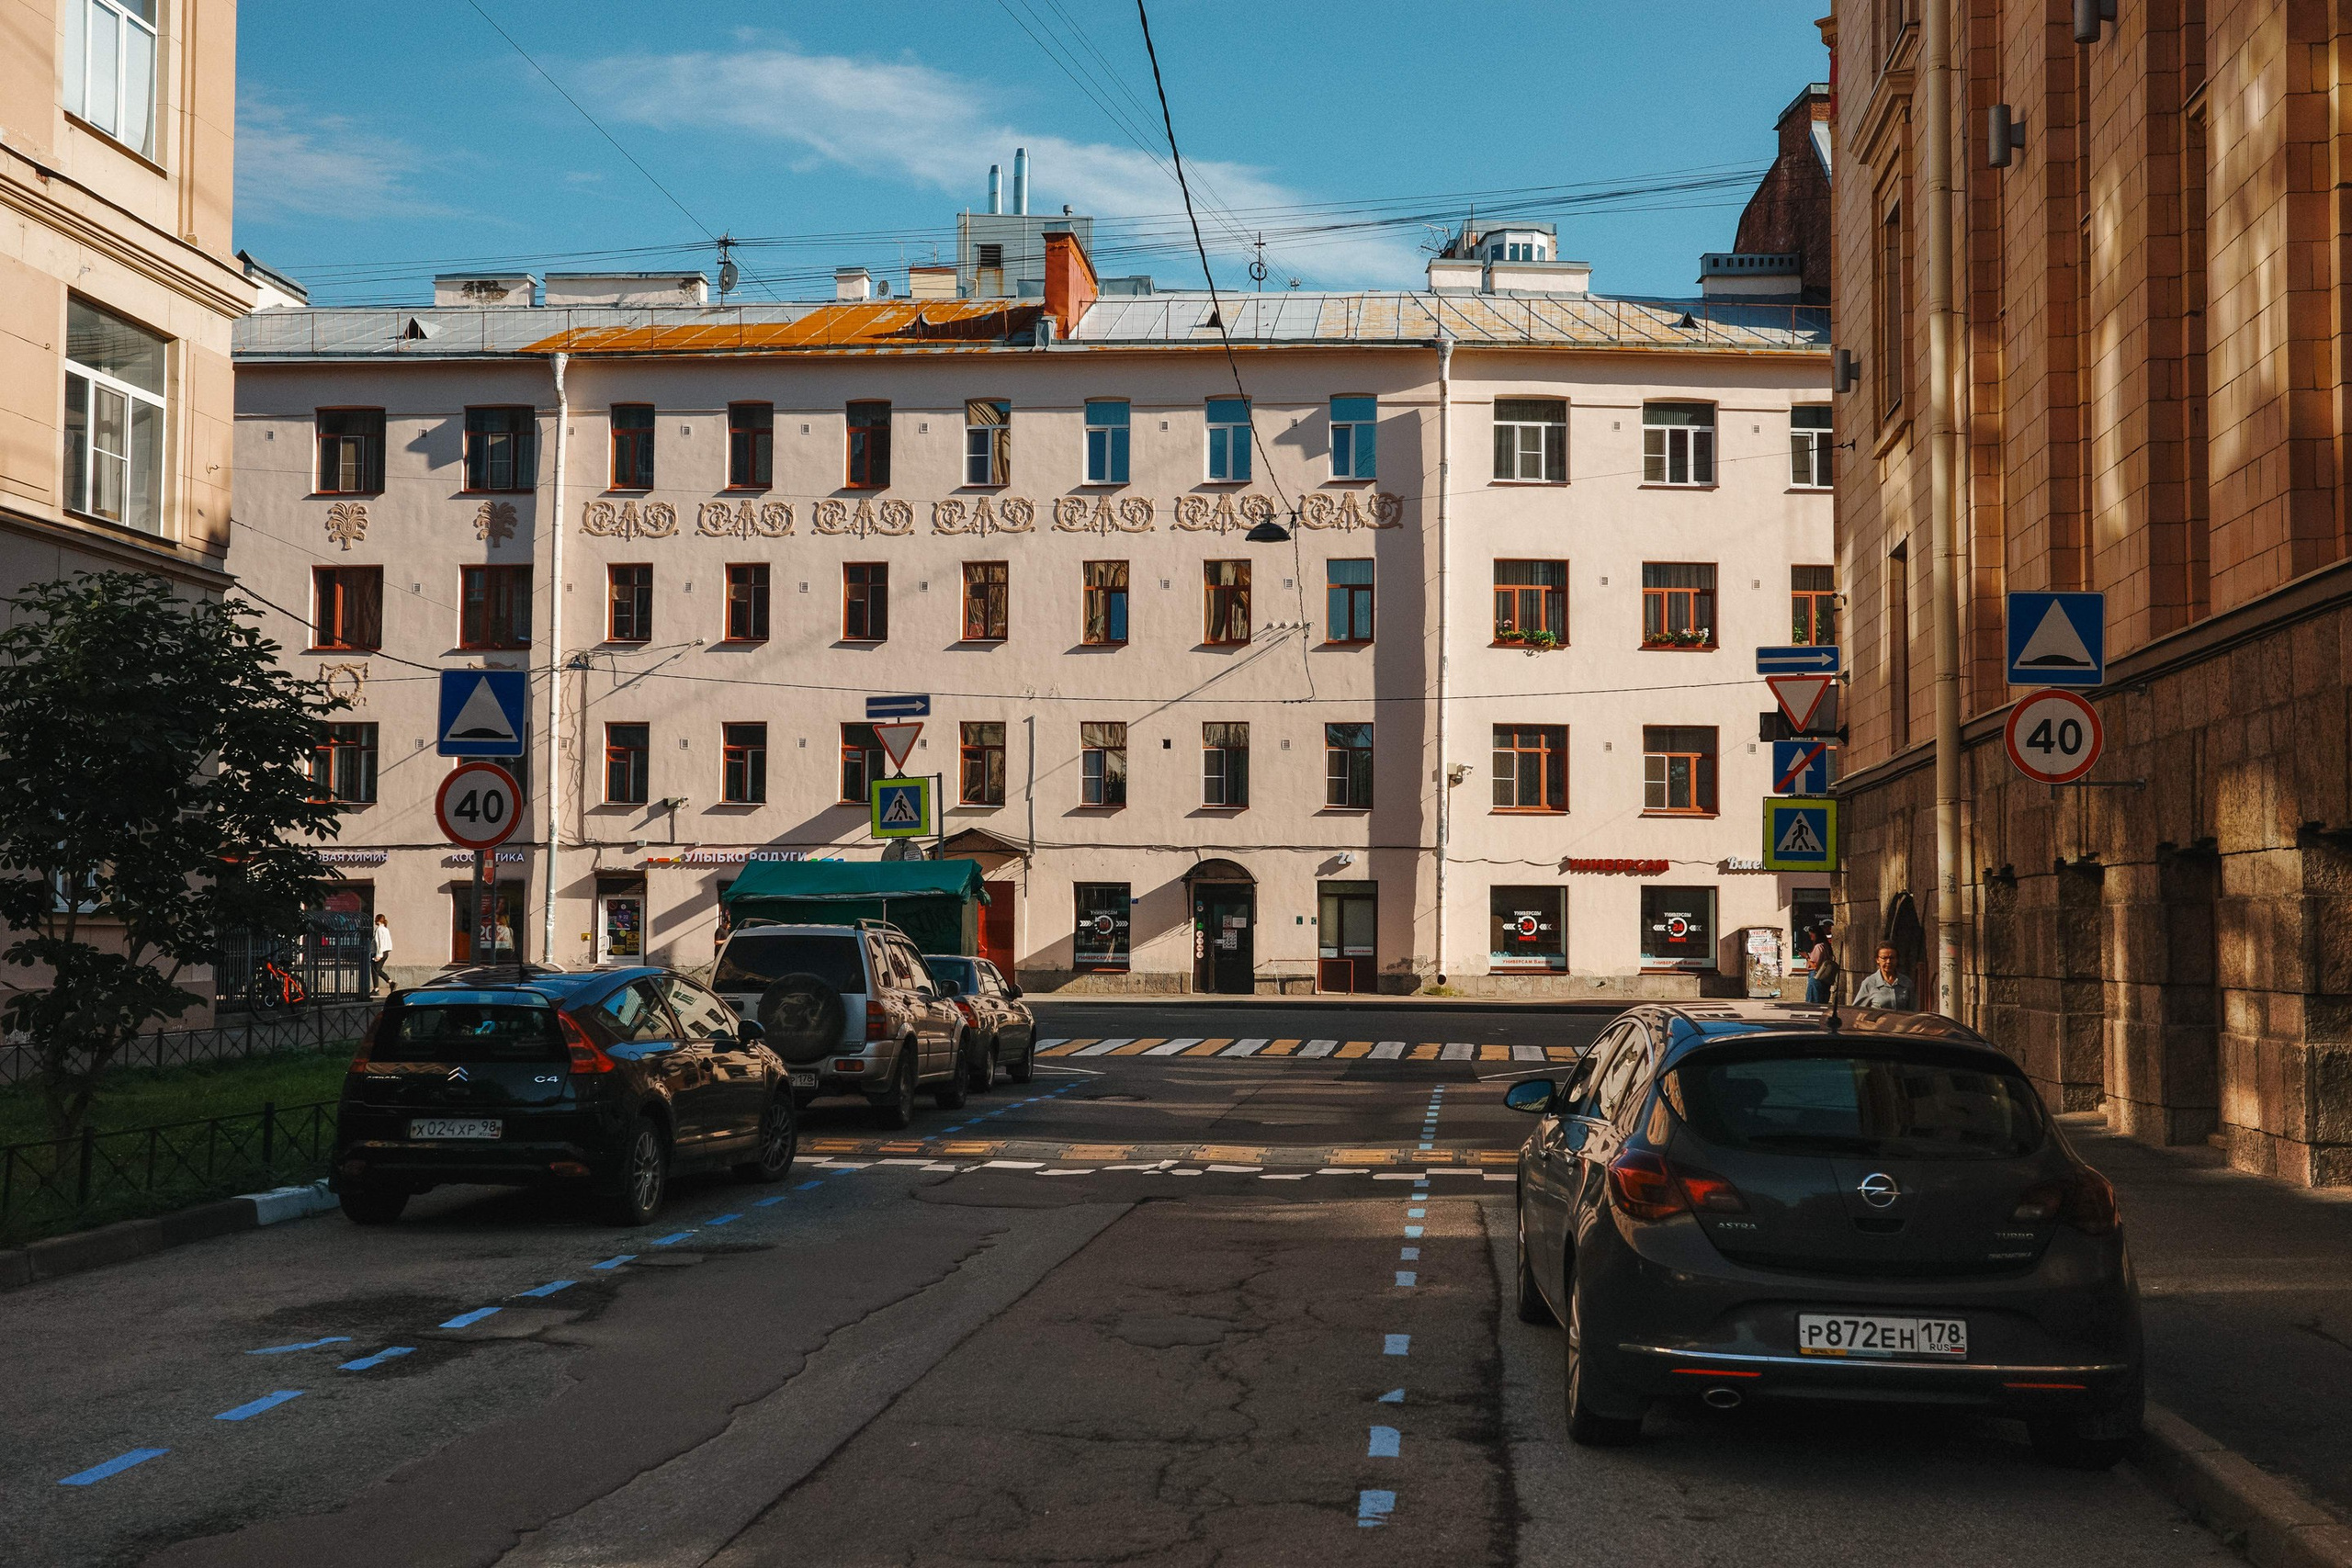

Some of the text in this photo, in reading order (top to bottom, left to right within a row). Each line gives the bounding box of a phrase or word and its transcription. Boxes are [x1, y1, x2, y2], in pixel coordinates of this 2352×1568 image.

[2026, 718, 2083, 755] 40
[454, 789, 504, 824] 40
[346, 852, 389, 862] ХИМИЯ
[452, 852, 524, 863] КОСТИКА
[1338, 852, 1355, 864] 24
[1727, 855, 1763, 870] Вме
[1568, 858, 1669, 872] УНИВЕРСАМ
[1522, 920, 1534, 931] 24
[1672, 922, 1684, 931] 24
[533, 1075, 559, 1083] C4
[797, 1074, 813, 1083] 178
[481, 1120, 497, 1132] 98
[1718, 1222, 1757, 1230] ASTRA
[1920, 1322, 1961, 1344] 178
[1929, 1343, 1951, 1352] RUS
